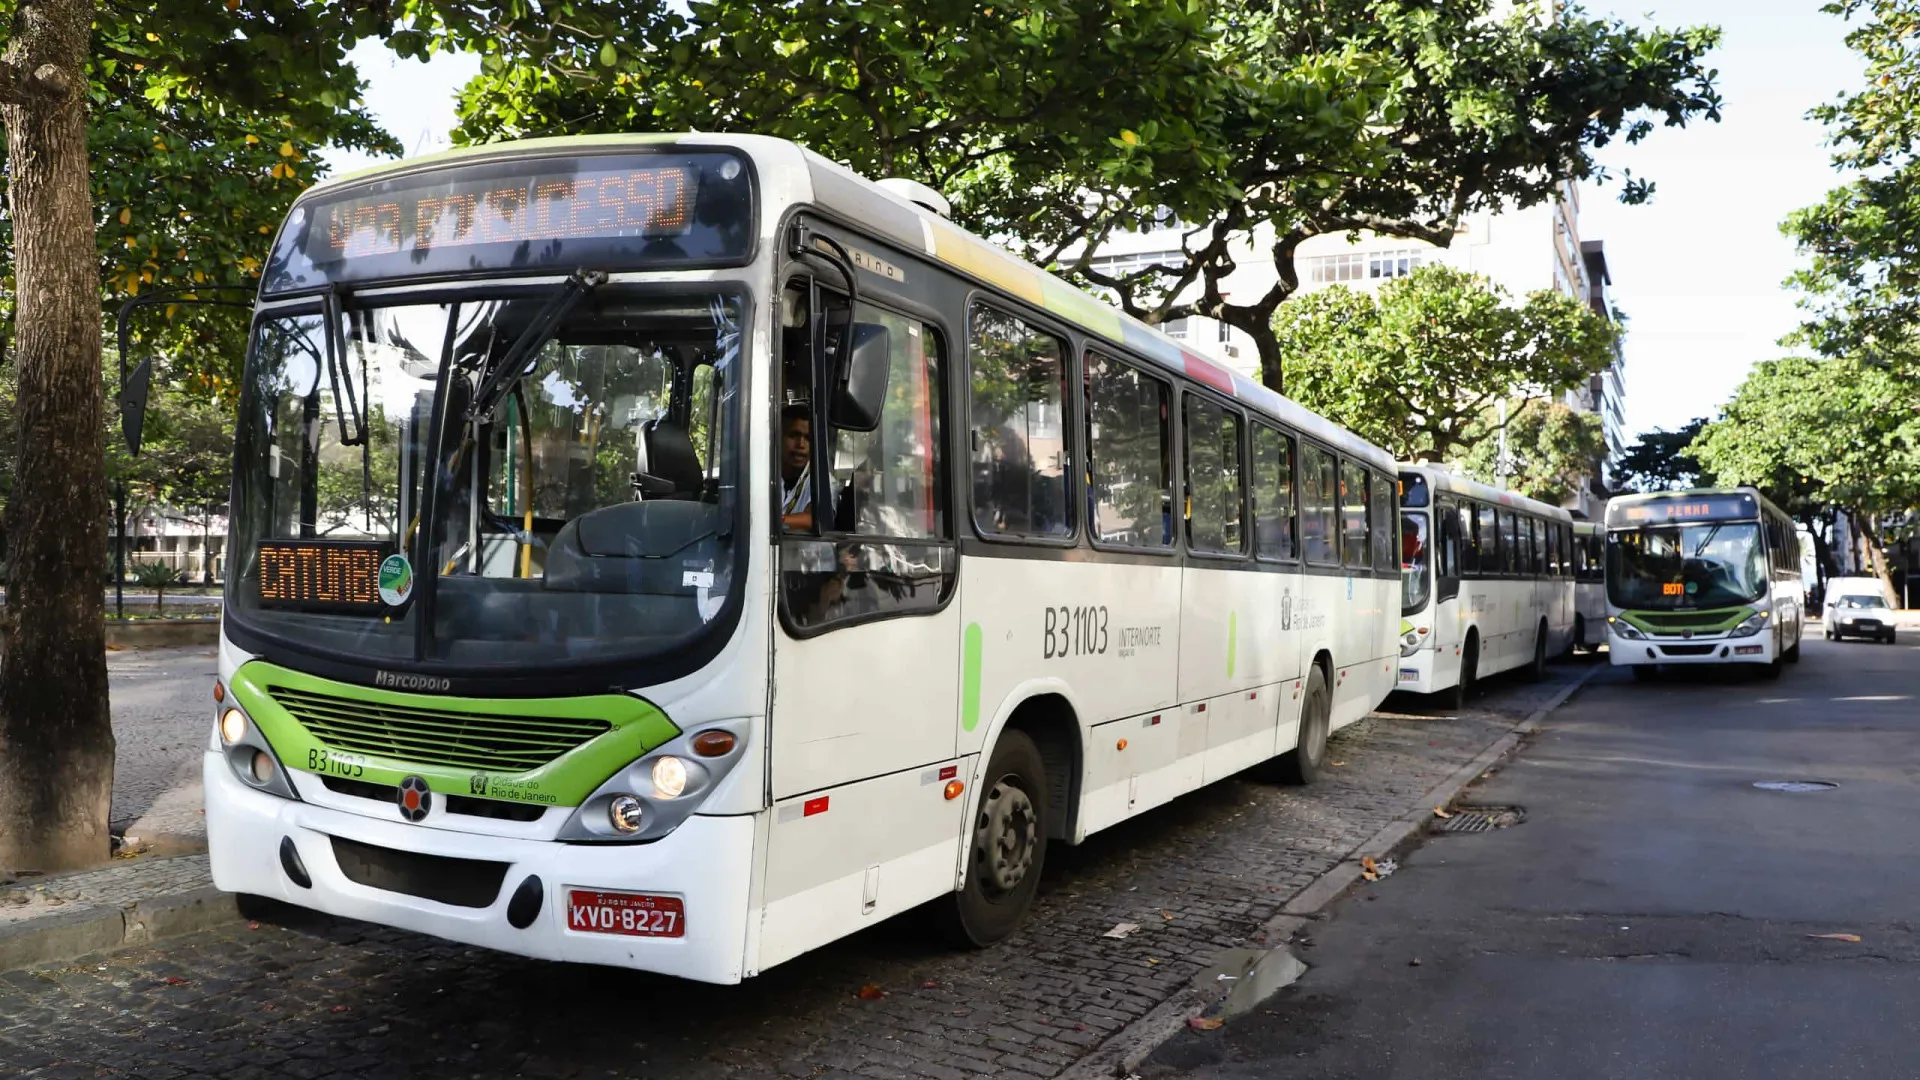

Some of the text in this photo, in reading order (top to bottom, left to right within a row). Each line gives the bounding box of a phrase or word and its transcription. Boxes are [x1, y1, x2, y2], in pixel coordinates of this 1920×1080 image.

[417, 169, 684, 249] BONSUCESSO
[260, 547, 379, 603] CATUMBI
[383, 565, 402, 575] VERDE
[1043, 605, 1108, 659] B31103
[1119, 626, 1161, 648] INTERNORTE
[308, 748, 364, 777] B31103
[492, 786, 557, 803] Rio de Janeiro
[493, 776, 539, 790] Cidade do
